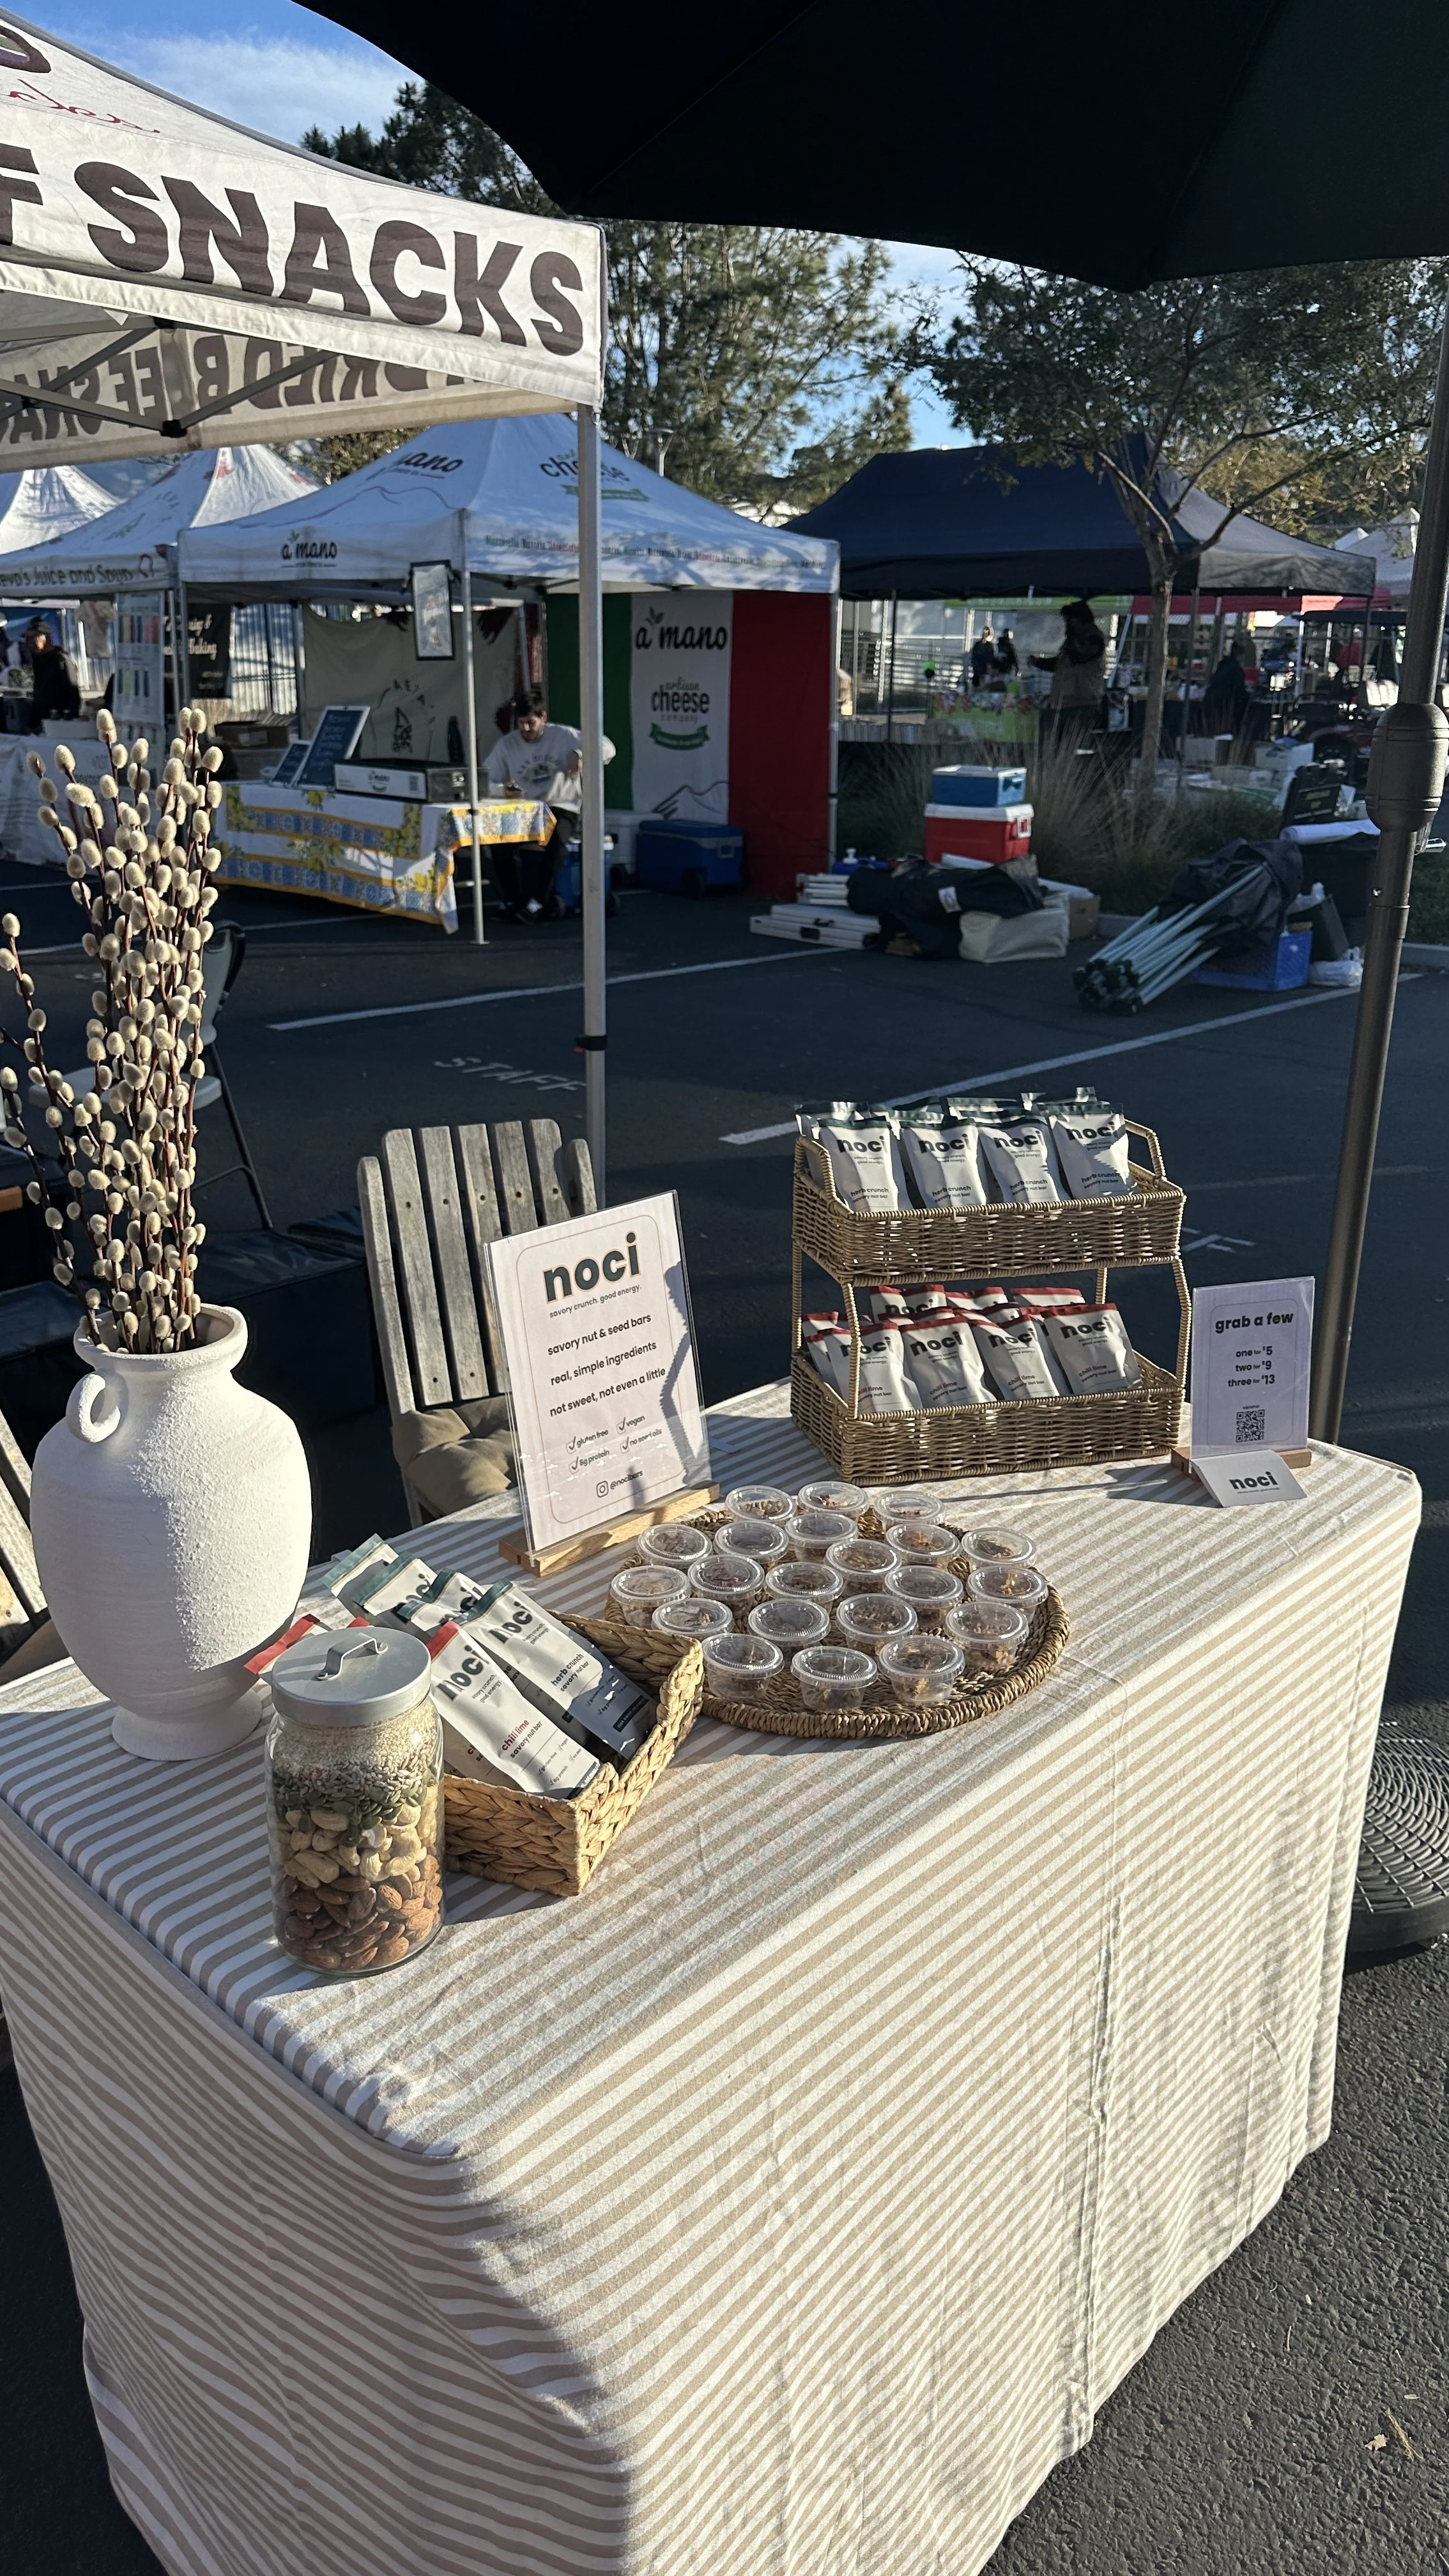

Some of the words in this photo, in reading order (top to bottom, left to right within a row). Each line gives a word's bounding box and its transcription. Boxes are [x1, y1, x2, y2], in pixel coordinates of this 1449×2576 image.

[74, 162, 584, 356] SNACKS
[295, 542, 338, 559] mano
[635, 626, 652, 650] a
[659, 625, 728, 650] mano
[650, 684, 710, 714] cheese
[993, 1130, 1045, 1148] noci
[1066, 1121, 1119, 1140] noci
[836, 1135, 887, 1153] noci
[918, 1133, 972, 1154] noci
[850, 1188, 866, 1197] herb
[932, 1187, 947, 1197] herb
[543, 1231, 640, 1303] noci
[549, 1306, 572, 1318] savory
[599, 1291, 616, 1303] good
[1061, 1316, 1114, 1339] noci
[1215, 1315, 1251, 1334] grab
[1254, 1316, 1263, 1326] a
[1266, 1312, 1294, 1325] few
[548, 1338, 580, 1356] savory
[581, 1331, 598, 1344] nut
[599, 1329, 607, 1338] &
[608, 1319, 629, 1335] seed
[631, 1314, 652, 1328] bars
[910, 1331, 963, 1356] noci
[988, 1328, 1038, 1348] noci
[1236, 1349, 1253, 1358] one
[1262, 1346, 1273, 1355] $5
[551, 1370, 572, 1386] real,
[573, 1360, 605, 1378] simple
[605, 1342, 657, 1366] ingredients
[1235, 1364, 1252, 1372] two
[1262, 1360, 1272, 1370] $9
[1227, 1378, 1252, 1387] three
[1261, 1374, 1275, 1384] $13
[549, 1403, 567, 1417] not
[567, 1392, 598, 1410] sweet,
[599, 1385, 615, 1399] not
[616, 1377, 638, 1393] even
[639, 1376, 645, 1384] a
[647, 1367, 666, 1382] little
[625, 1415, 645, 1427] vegan
[576, 1434, 596, 1448] gluten
[596, 1429, 609, 1438] free
[629, 1438, 638, 1446] no
[588, 1449, 610, 1465] protein
[610, 1469, 643, 1490] @nocibars
[1229, 1471, 1278, 1490] noci
[551, 1669, 568, 1686] herb
[566, 1653, 584, 1670] crunch
[560, 1671, 578, 1692] savory
[576, 1666, 585, 1675] nut
[502, 1730, 518, 1751] chili
[516, 1719, 530, 1735] lime
[510, 1737, 530, 1759] savory
[527, 1729, 536, 1739] nut
[534, 1721, 543, 1731] bar
